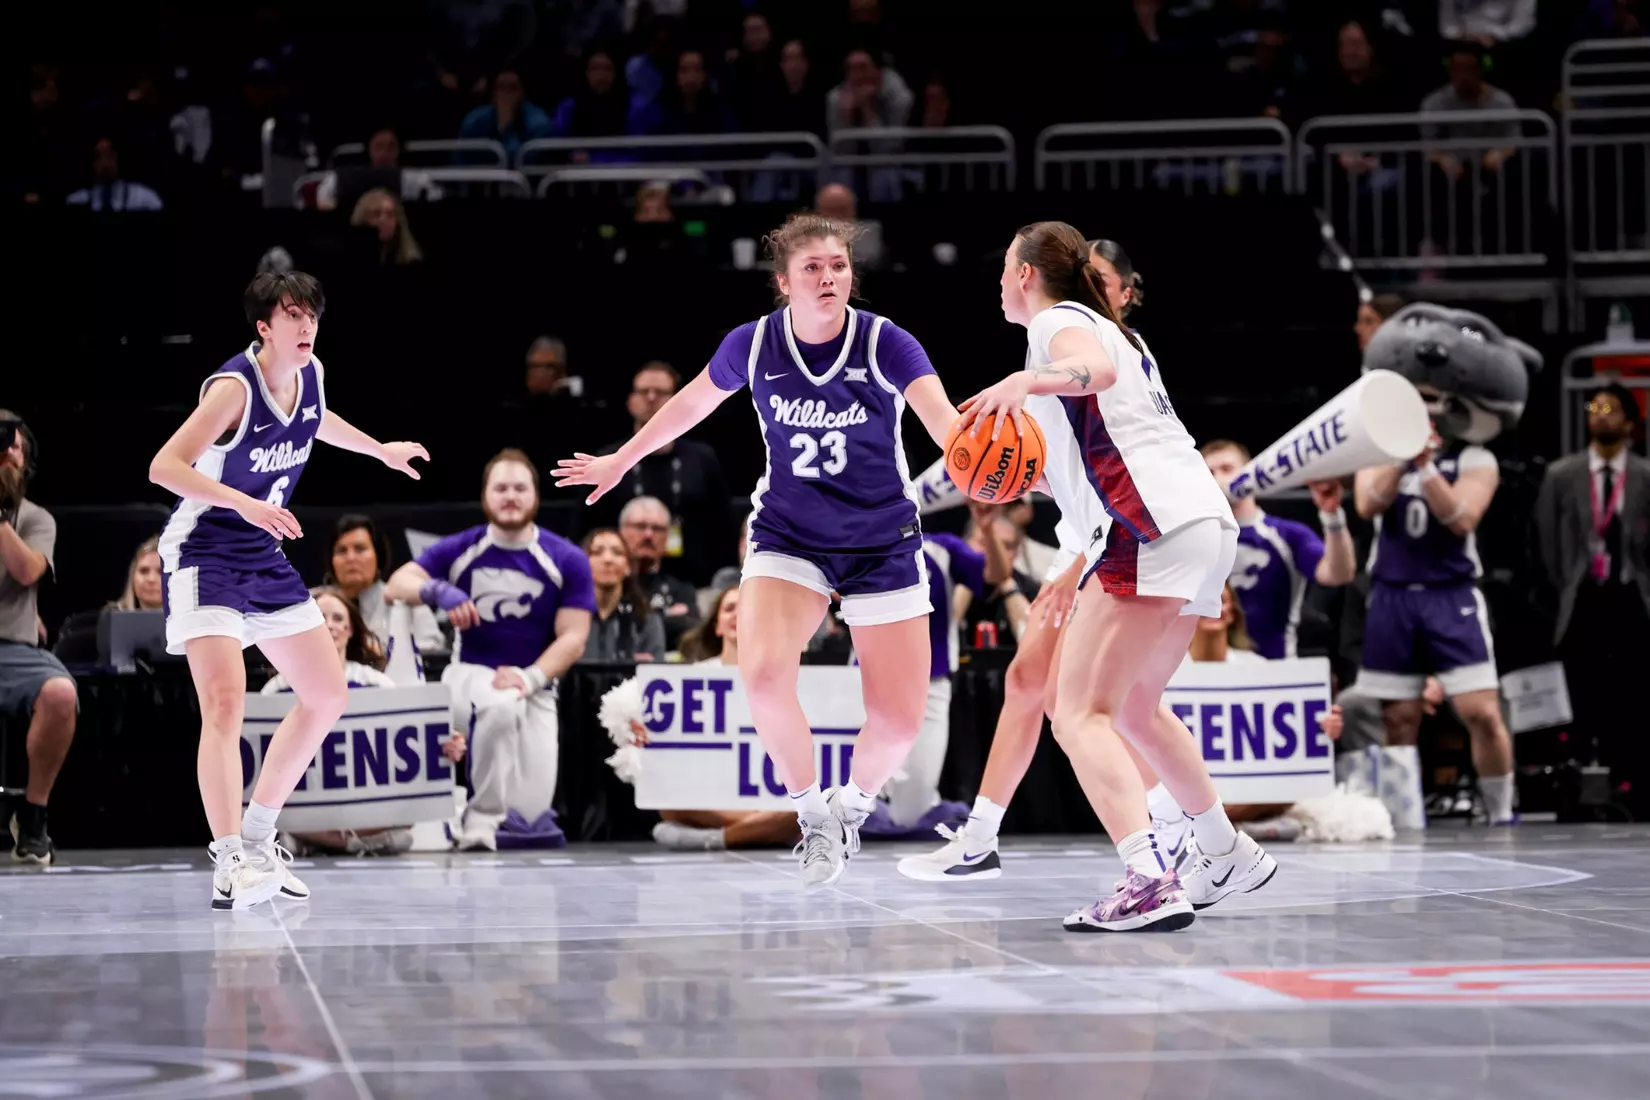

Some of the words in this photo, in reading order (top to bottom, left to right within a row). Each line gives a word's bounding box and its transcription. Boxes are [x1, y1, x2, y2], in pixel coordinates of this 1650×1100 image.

[769, 394, 869, 428] Wildcats
[789, 430, 848, 478] 23
[976, 446, 1015, 500] Wilson
[1254, 408, 1350, 491] K-STATE
[1405, 499, 1428, 539] 0
[642, 678, 733, 733] GET
[239, 723, 452, 790] DENSE
